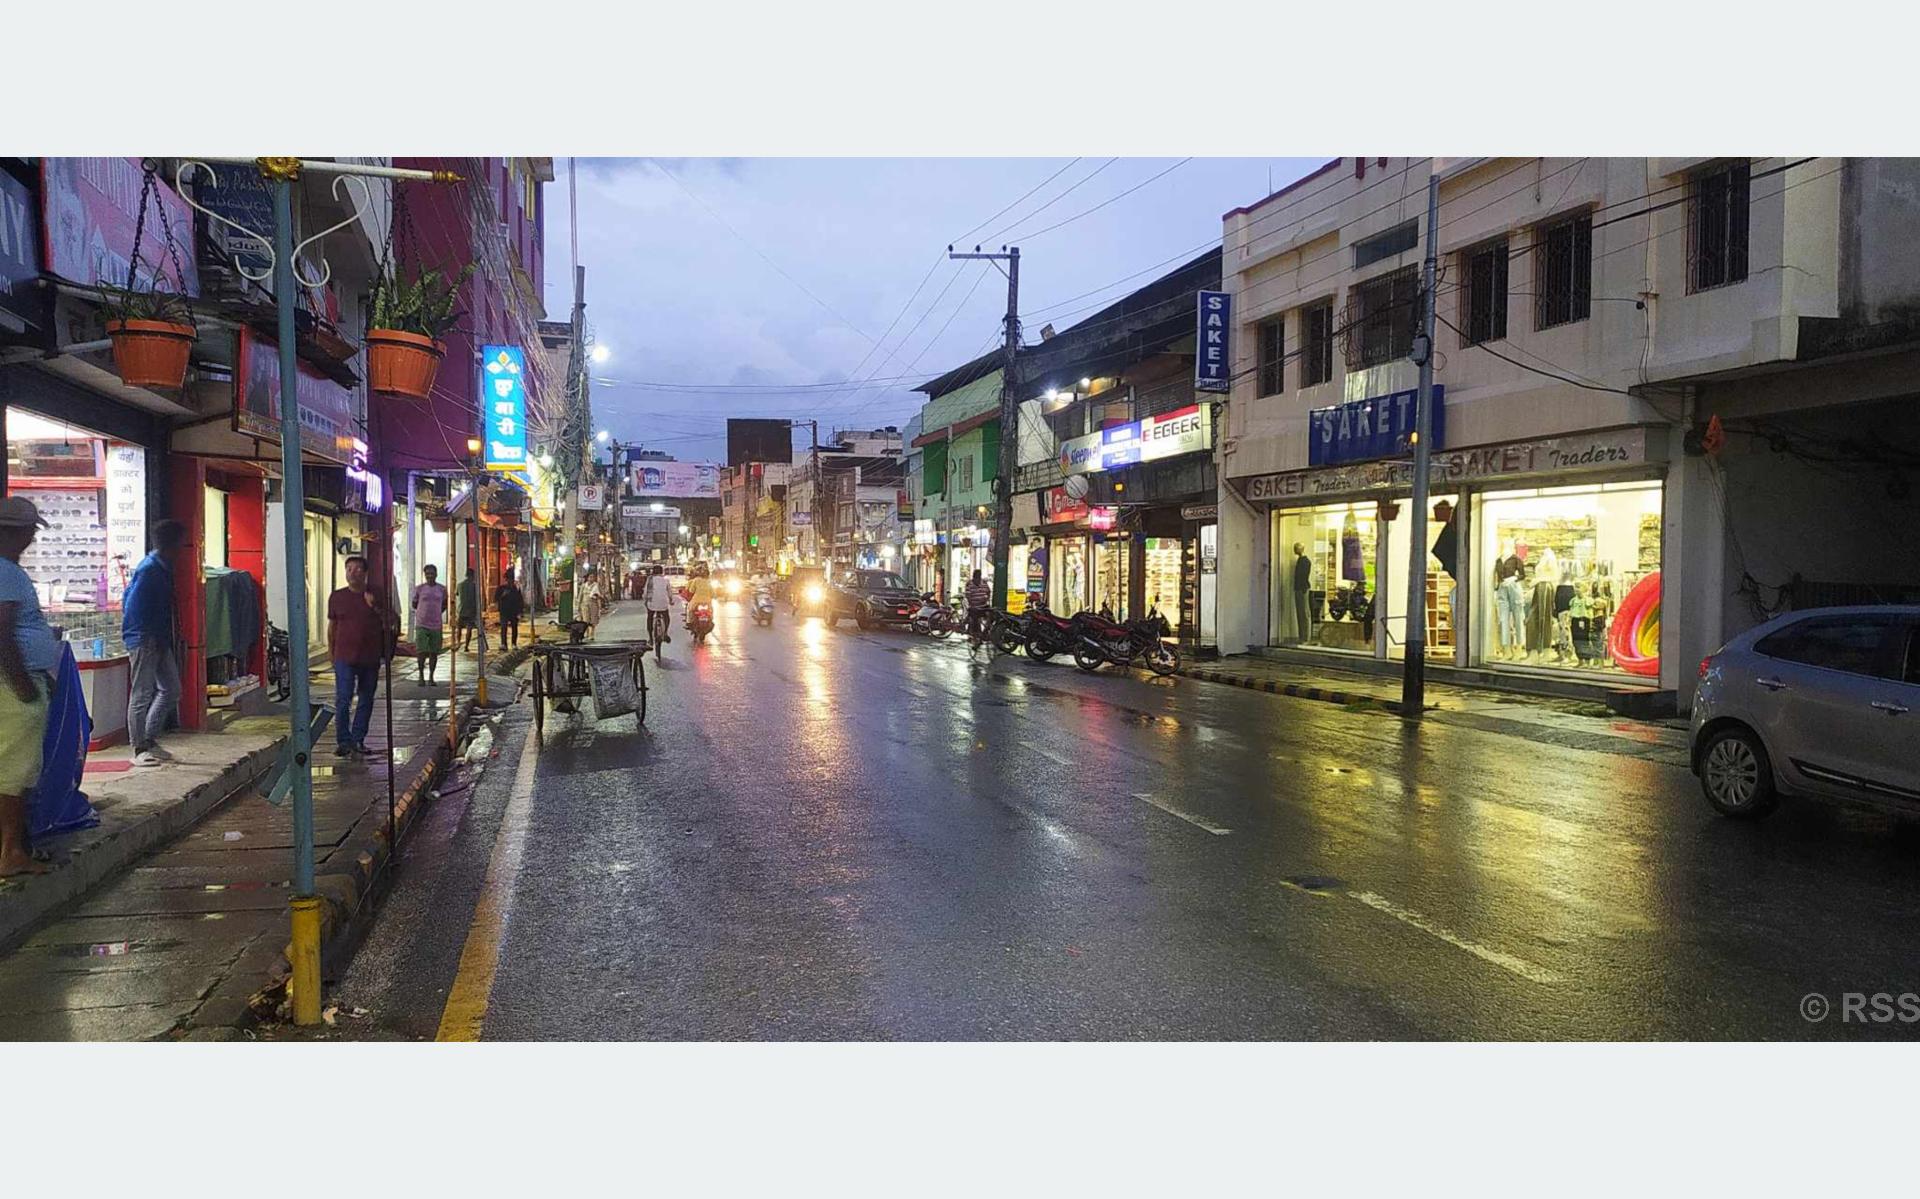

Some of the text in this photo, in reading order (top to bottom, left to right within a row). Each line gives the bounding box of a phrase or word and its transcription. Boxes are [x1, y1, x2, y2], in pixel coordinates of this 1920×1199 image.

[1207, 296, 1222, 377] SAKET
[1153, 416, 1201, 440] EGGER
[1321, 394, 1412, 444] SAKET
[1450, 446, 1541, 477] SAKET
[1549, 444, 1630, 469] Traders
[1253, 474, 1352, 498] SAKET Traders
